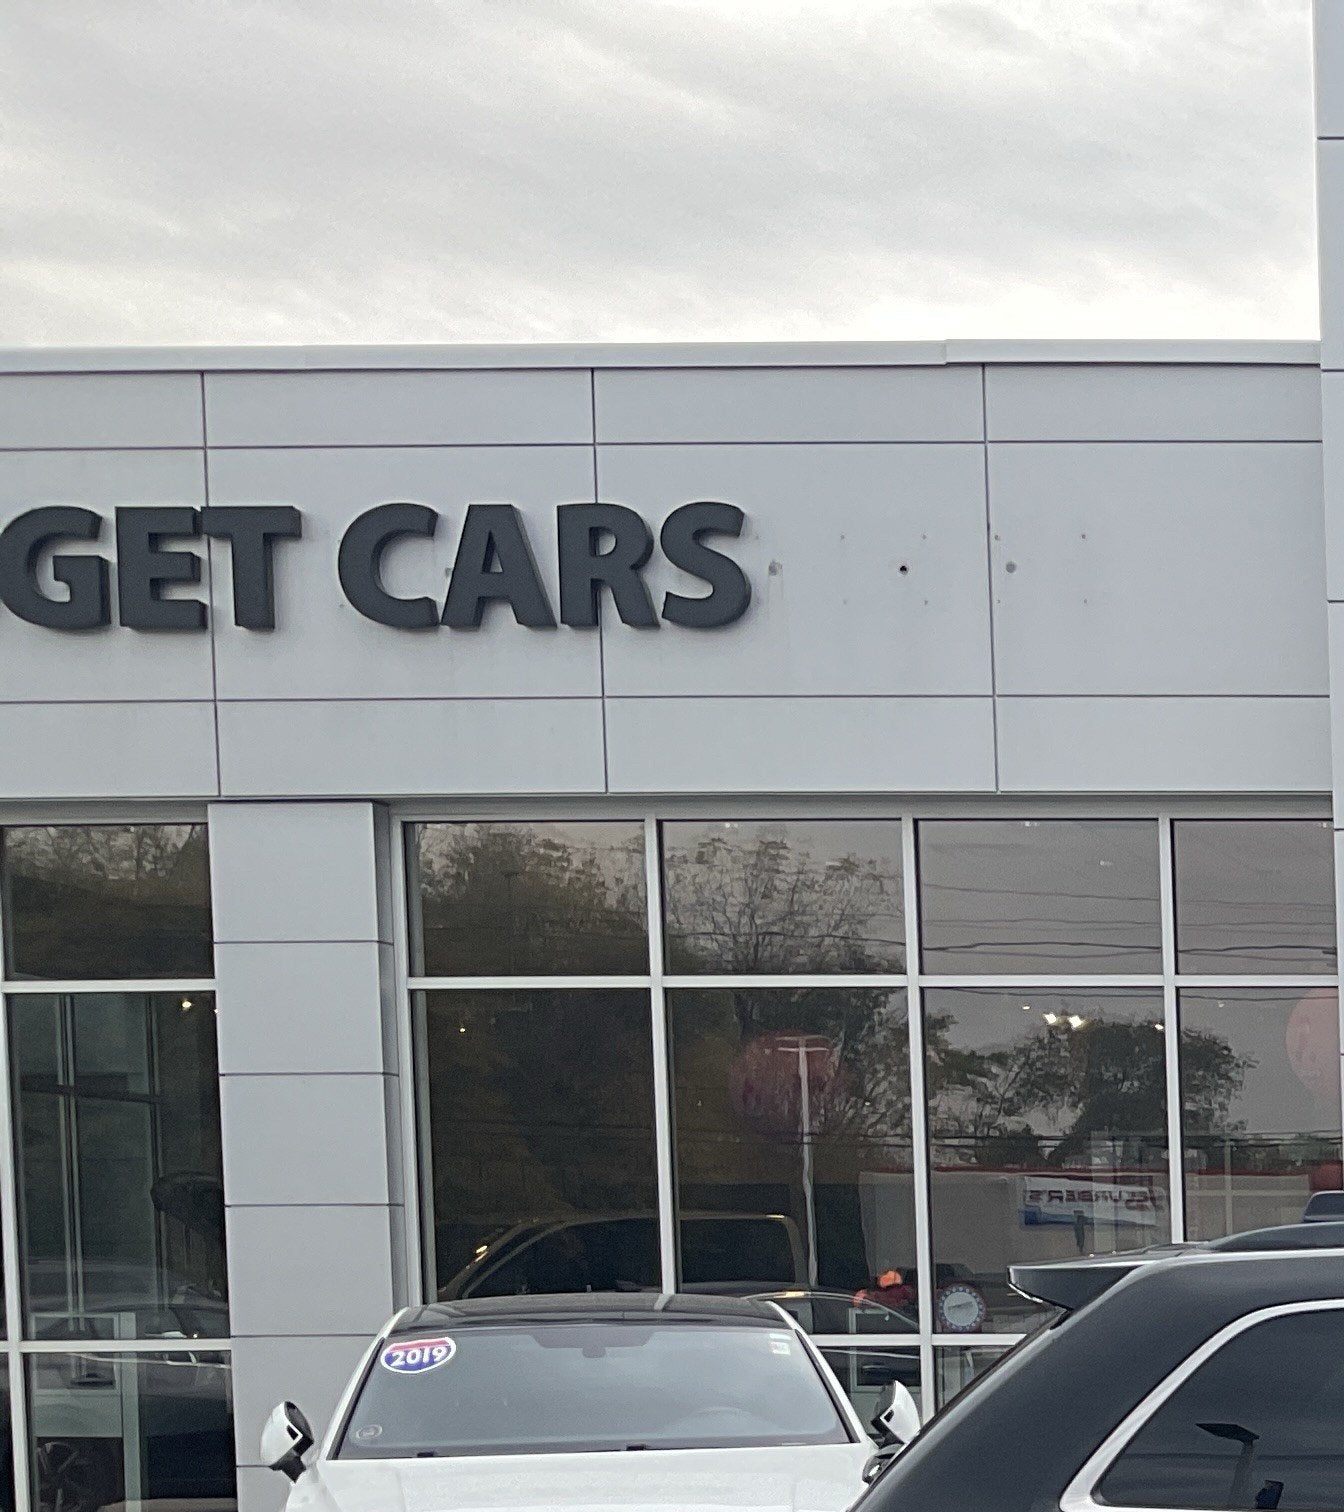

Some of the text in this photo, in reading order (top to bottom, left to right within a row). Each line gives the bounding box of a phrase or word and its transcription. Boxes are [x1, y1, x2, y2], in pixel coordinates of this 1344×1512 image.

[0, 501, 752, 631] GET CARS
[389, 1345, 449, 1367] 2019
